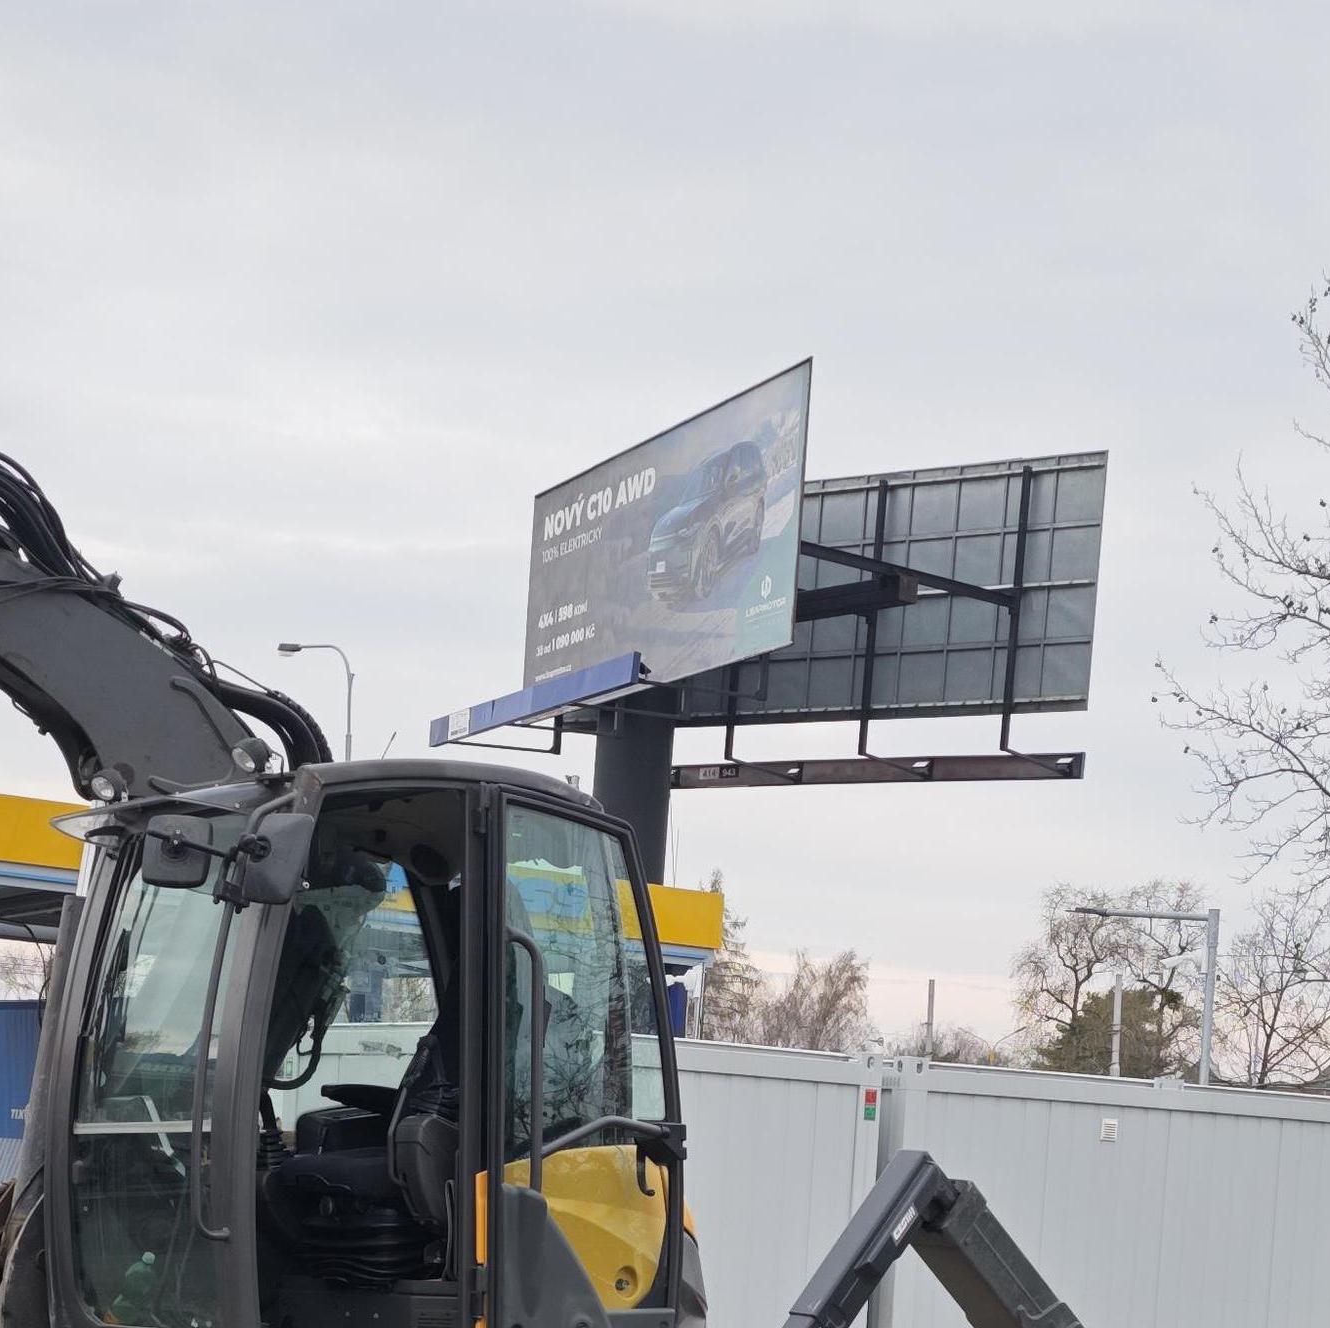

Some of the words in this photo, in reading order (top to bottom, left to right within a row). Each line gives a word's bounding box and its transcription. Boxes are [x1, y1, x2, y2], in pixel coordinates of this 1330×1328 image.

[543, 493, 586, 541] NOVÝ
[587, 487, 612, 521] C10
[615, 468, 656, 509] AWD
